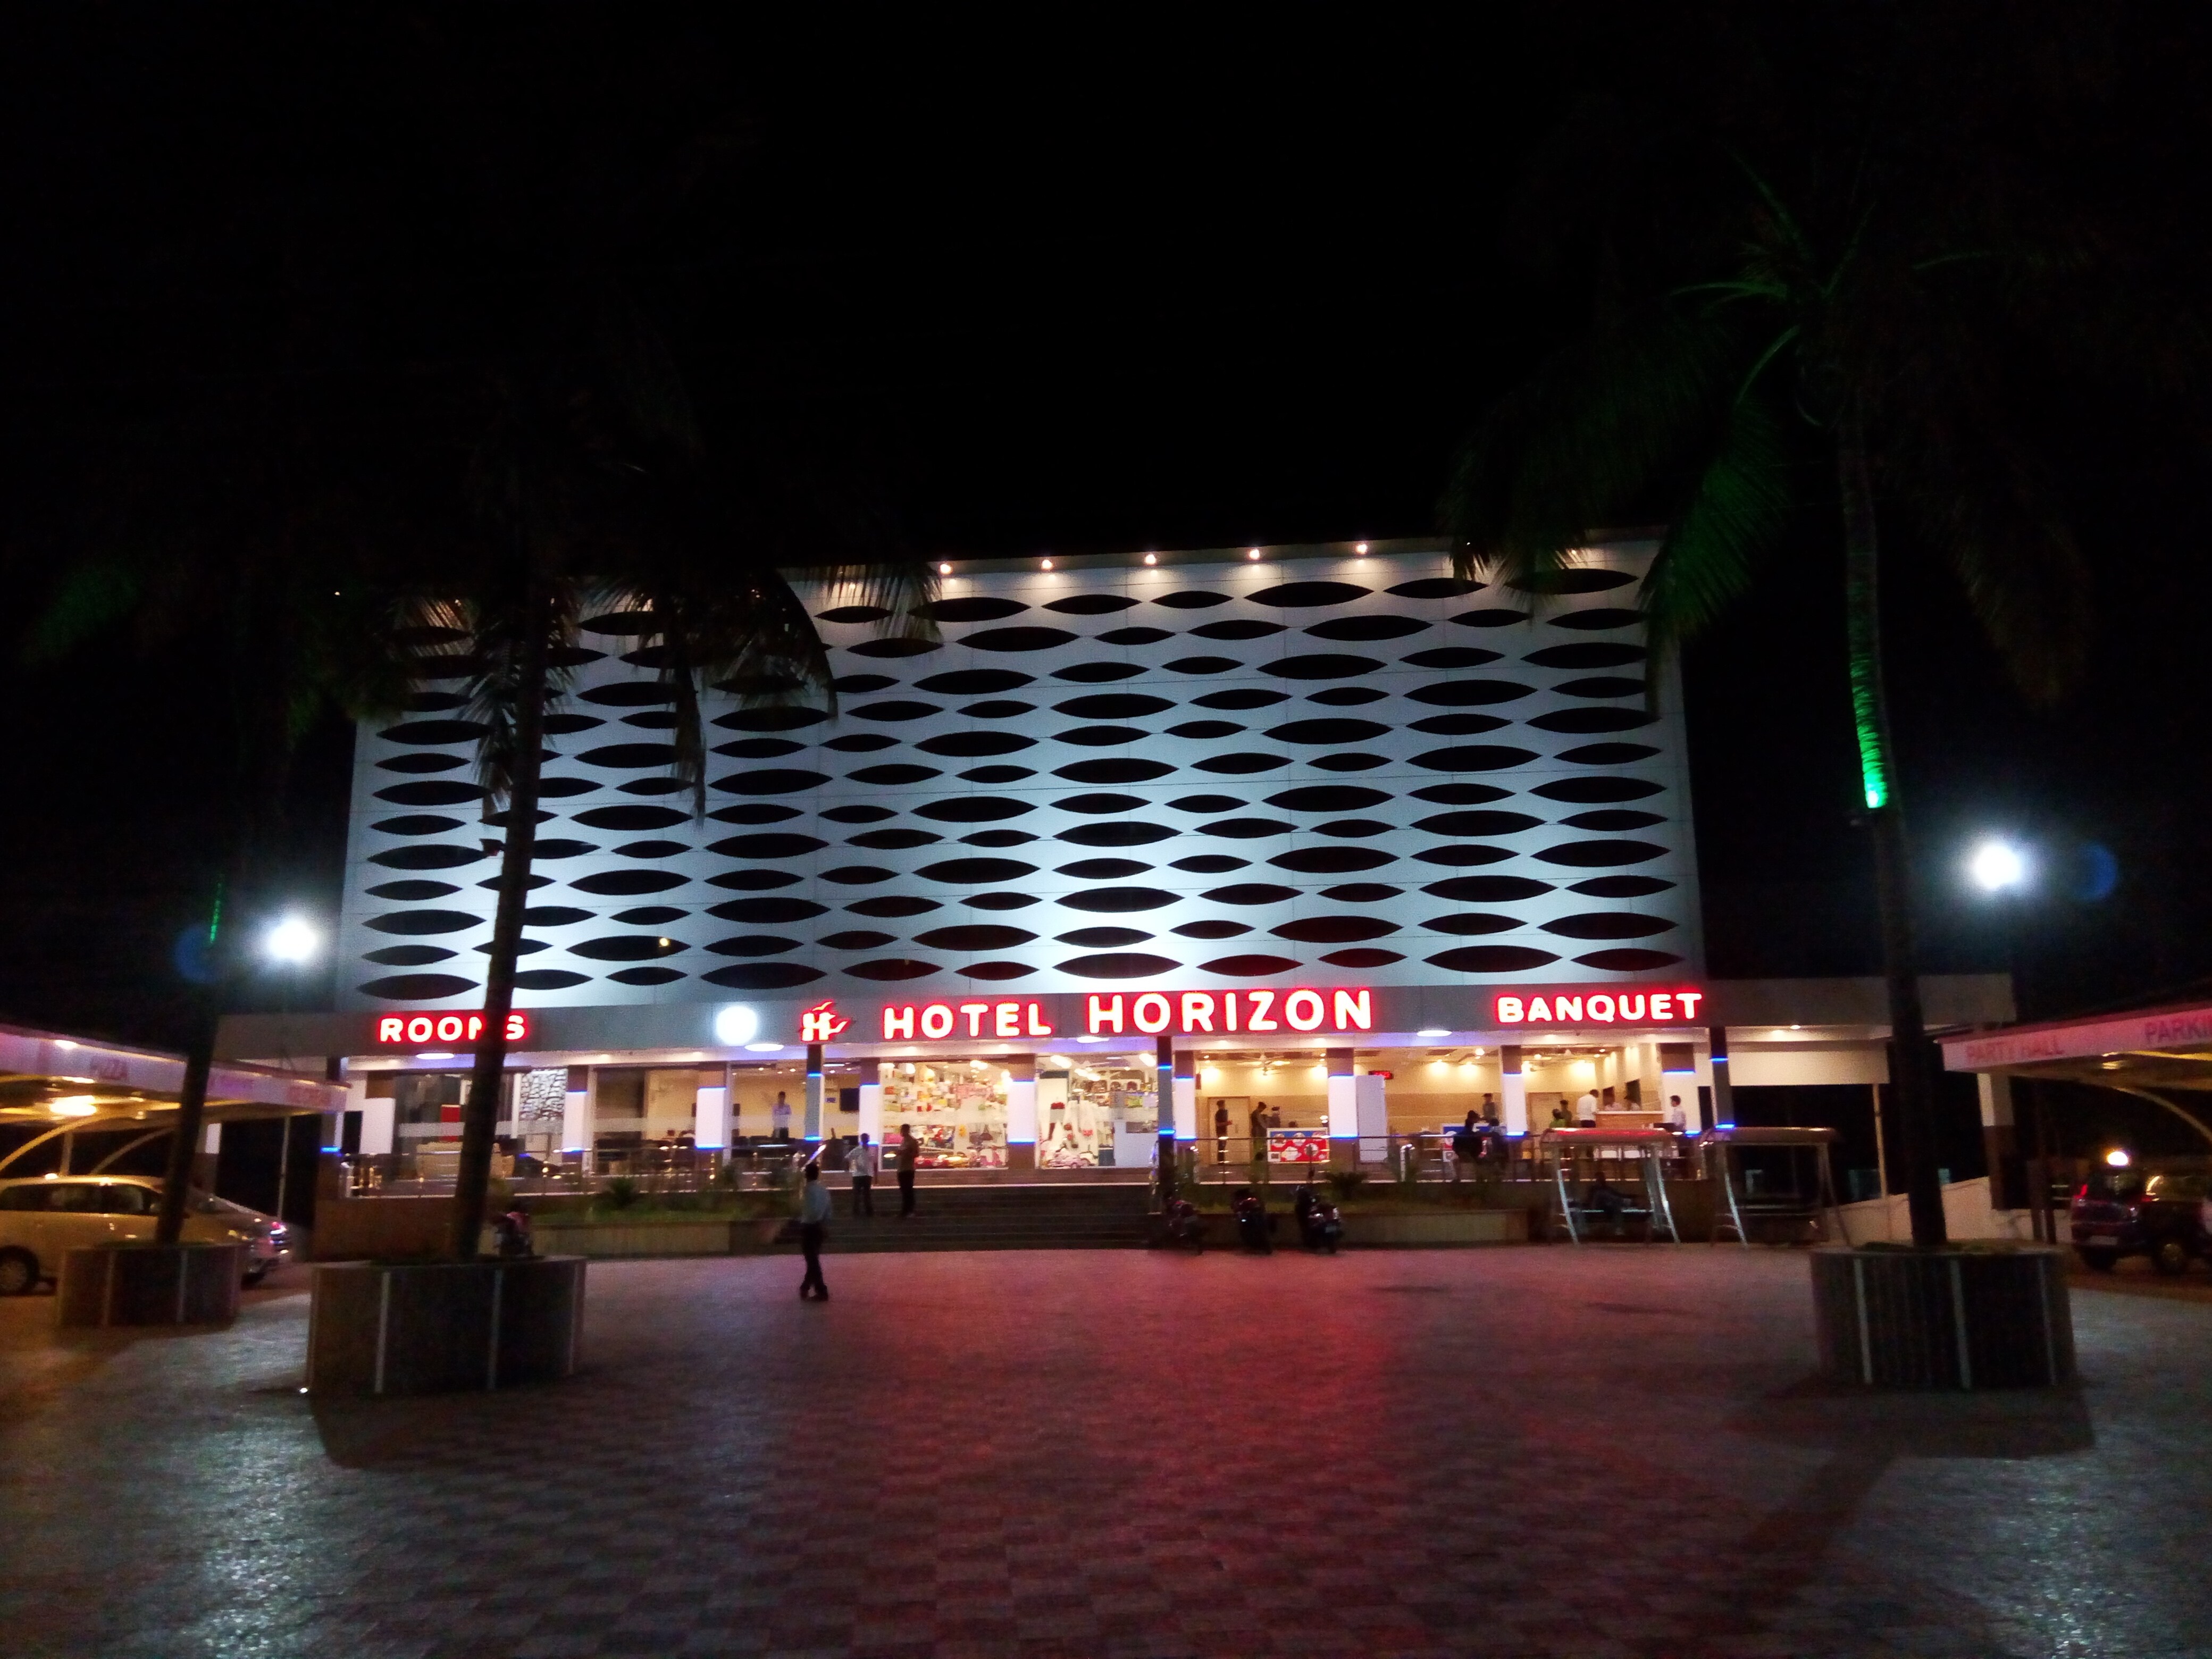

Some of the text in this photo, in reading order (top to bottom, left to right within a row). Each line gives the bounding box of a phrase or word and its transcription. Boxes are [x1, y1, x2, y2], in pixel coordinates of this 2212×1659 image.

[883, 990, 1371, 1040] HOTEL HORIZON
[1497, 992, 1703, 1023] BANQUET
